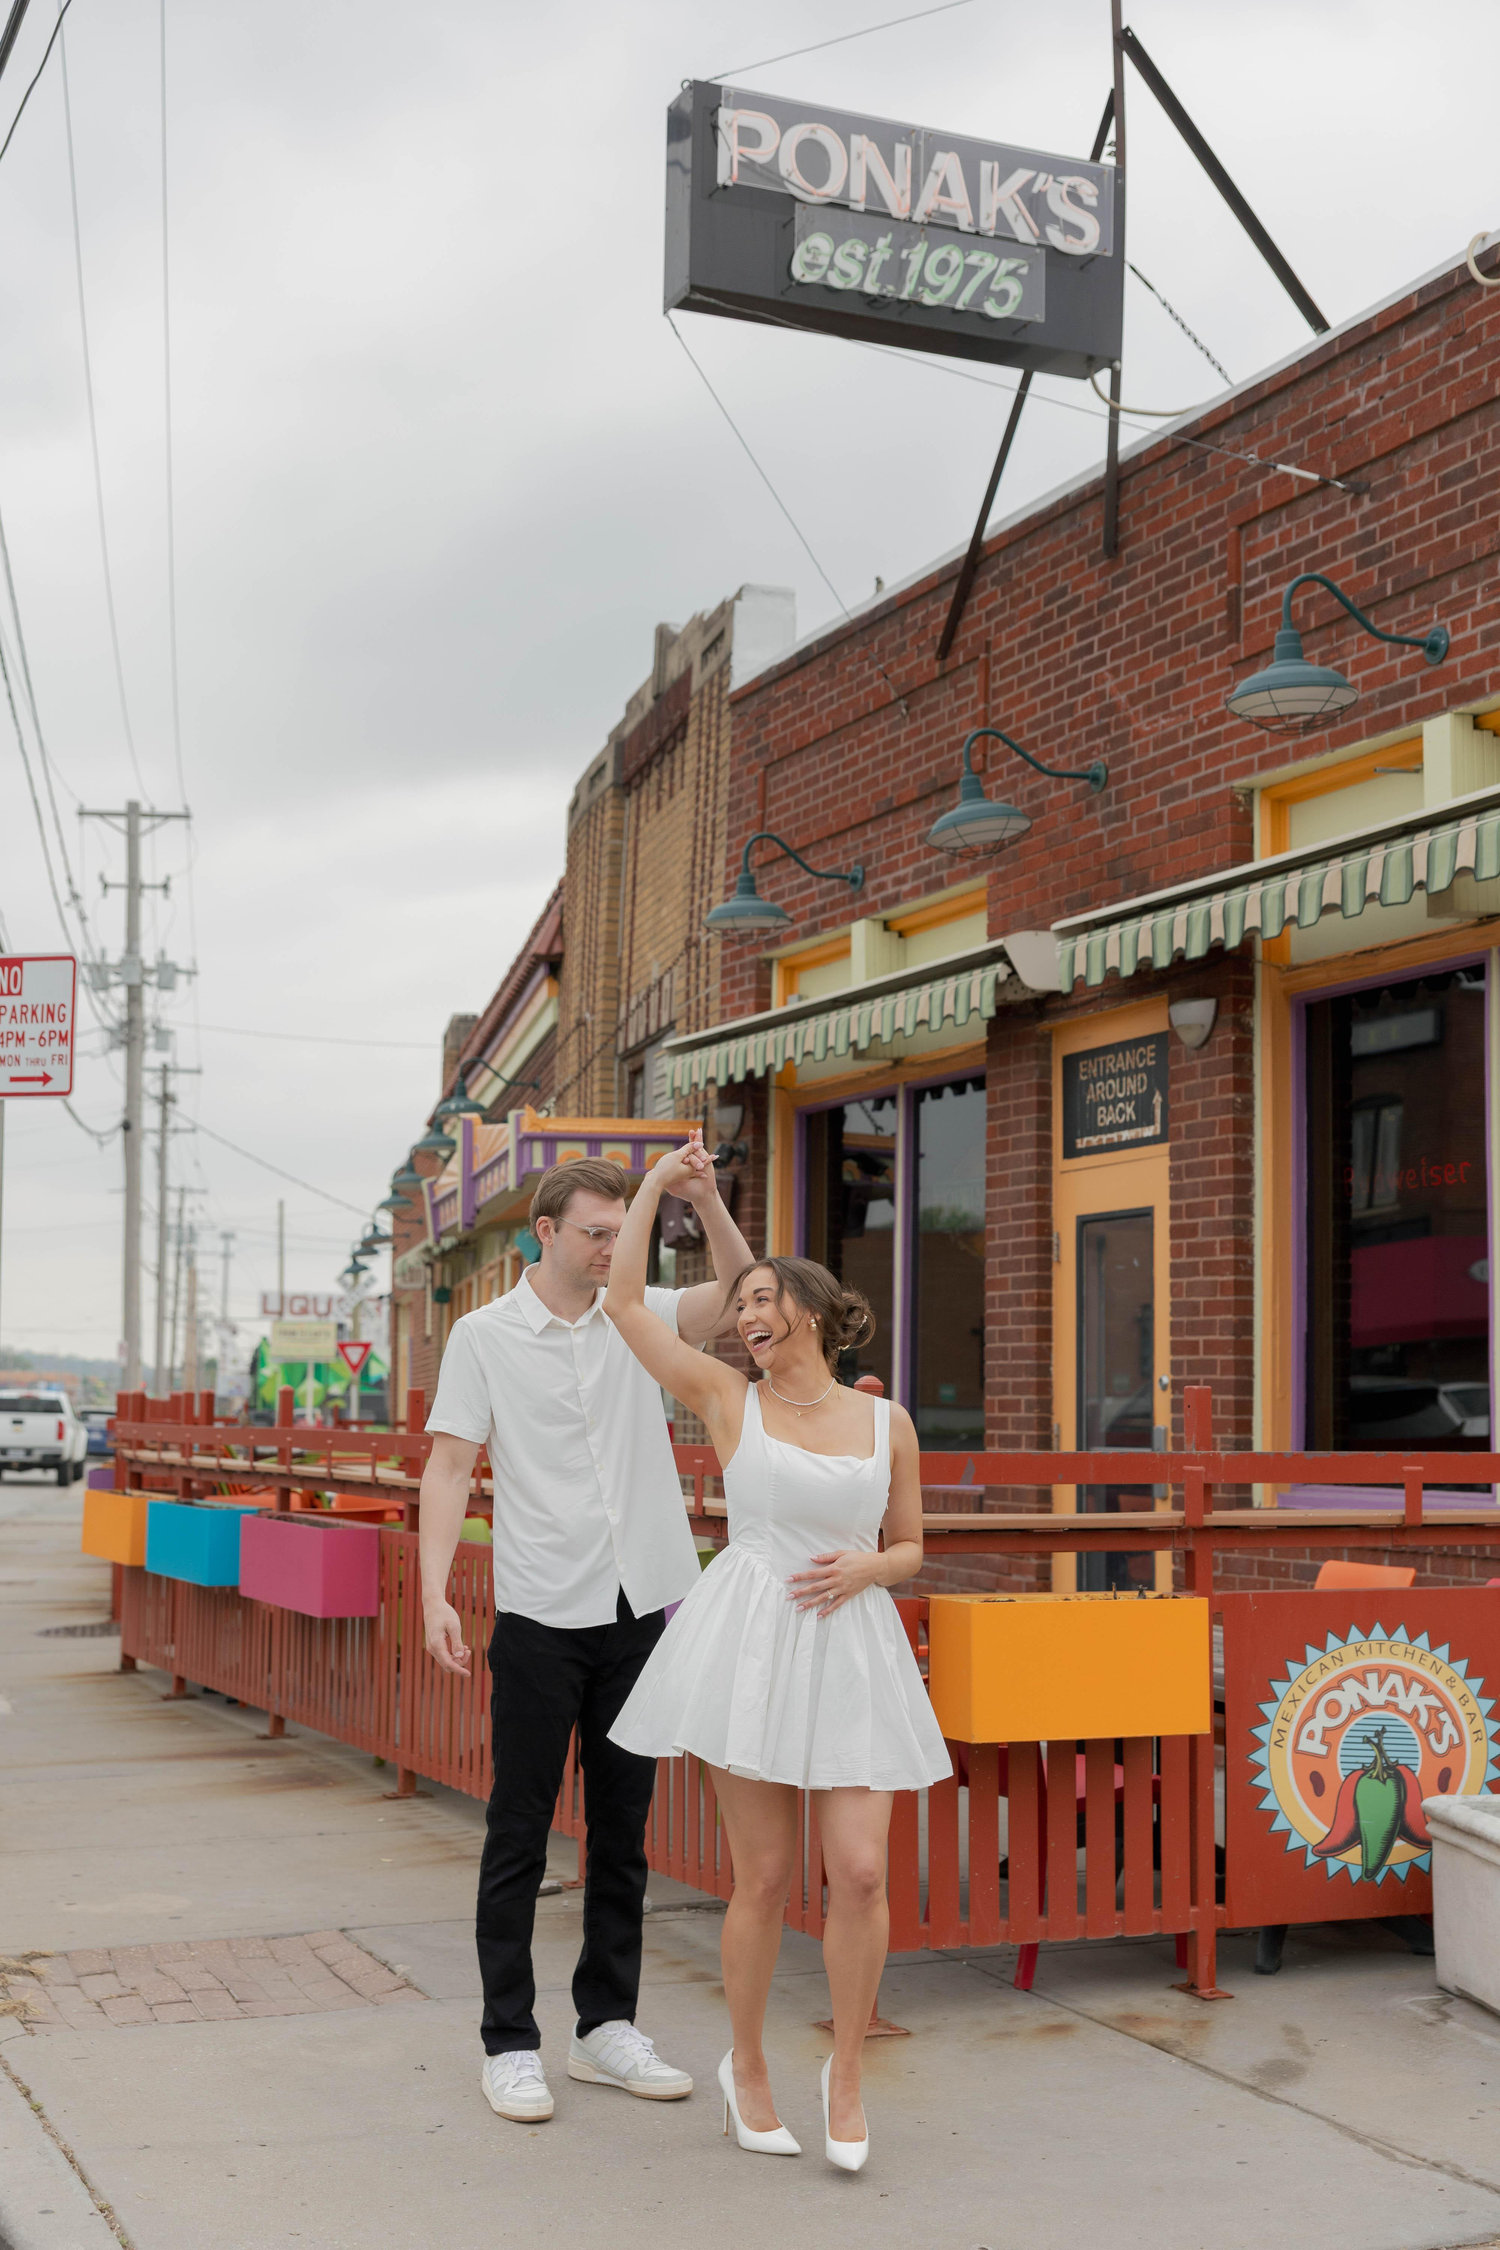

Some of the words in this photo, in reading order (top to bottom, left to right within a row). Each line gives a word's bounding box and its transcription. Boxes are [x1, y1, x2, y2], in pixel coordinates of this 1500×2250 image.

[717, 107, 1102, 256] PONAK'S
[901, 240, 1029, 319] 1975
[0, 966, 22, 995] NO
[0, 1003, 66, 1025] PARKING
[0, 1054, 21, 1067] MON
[51, 1053, 68, 1066] FRI
[1079, 1044, 1156, 1080] ENTRANCE
[1086, 1072, 1148, 1104] AROUND
[1097, 1100, 1137, 1127] BACK
[1273, 1651, 1344, 1749] MEXICAN
[1354, 1642, 1443, 1676] KITCHEN
[1445, 1675, 1457, 1690] &
[1458, 1692, 1484, 1743] BAR
